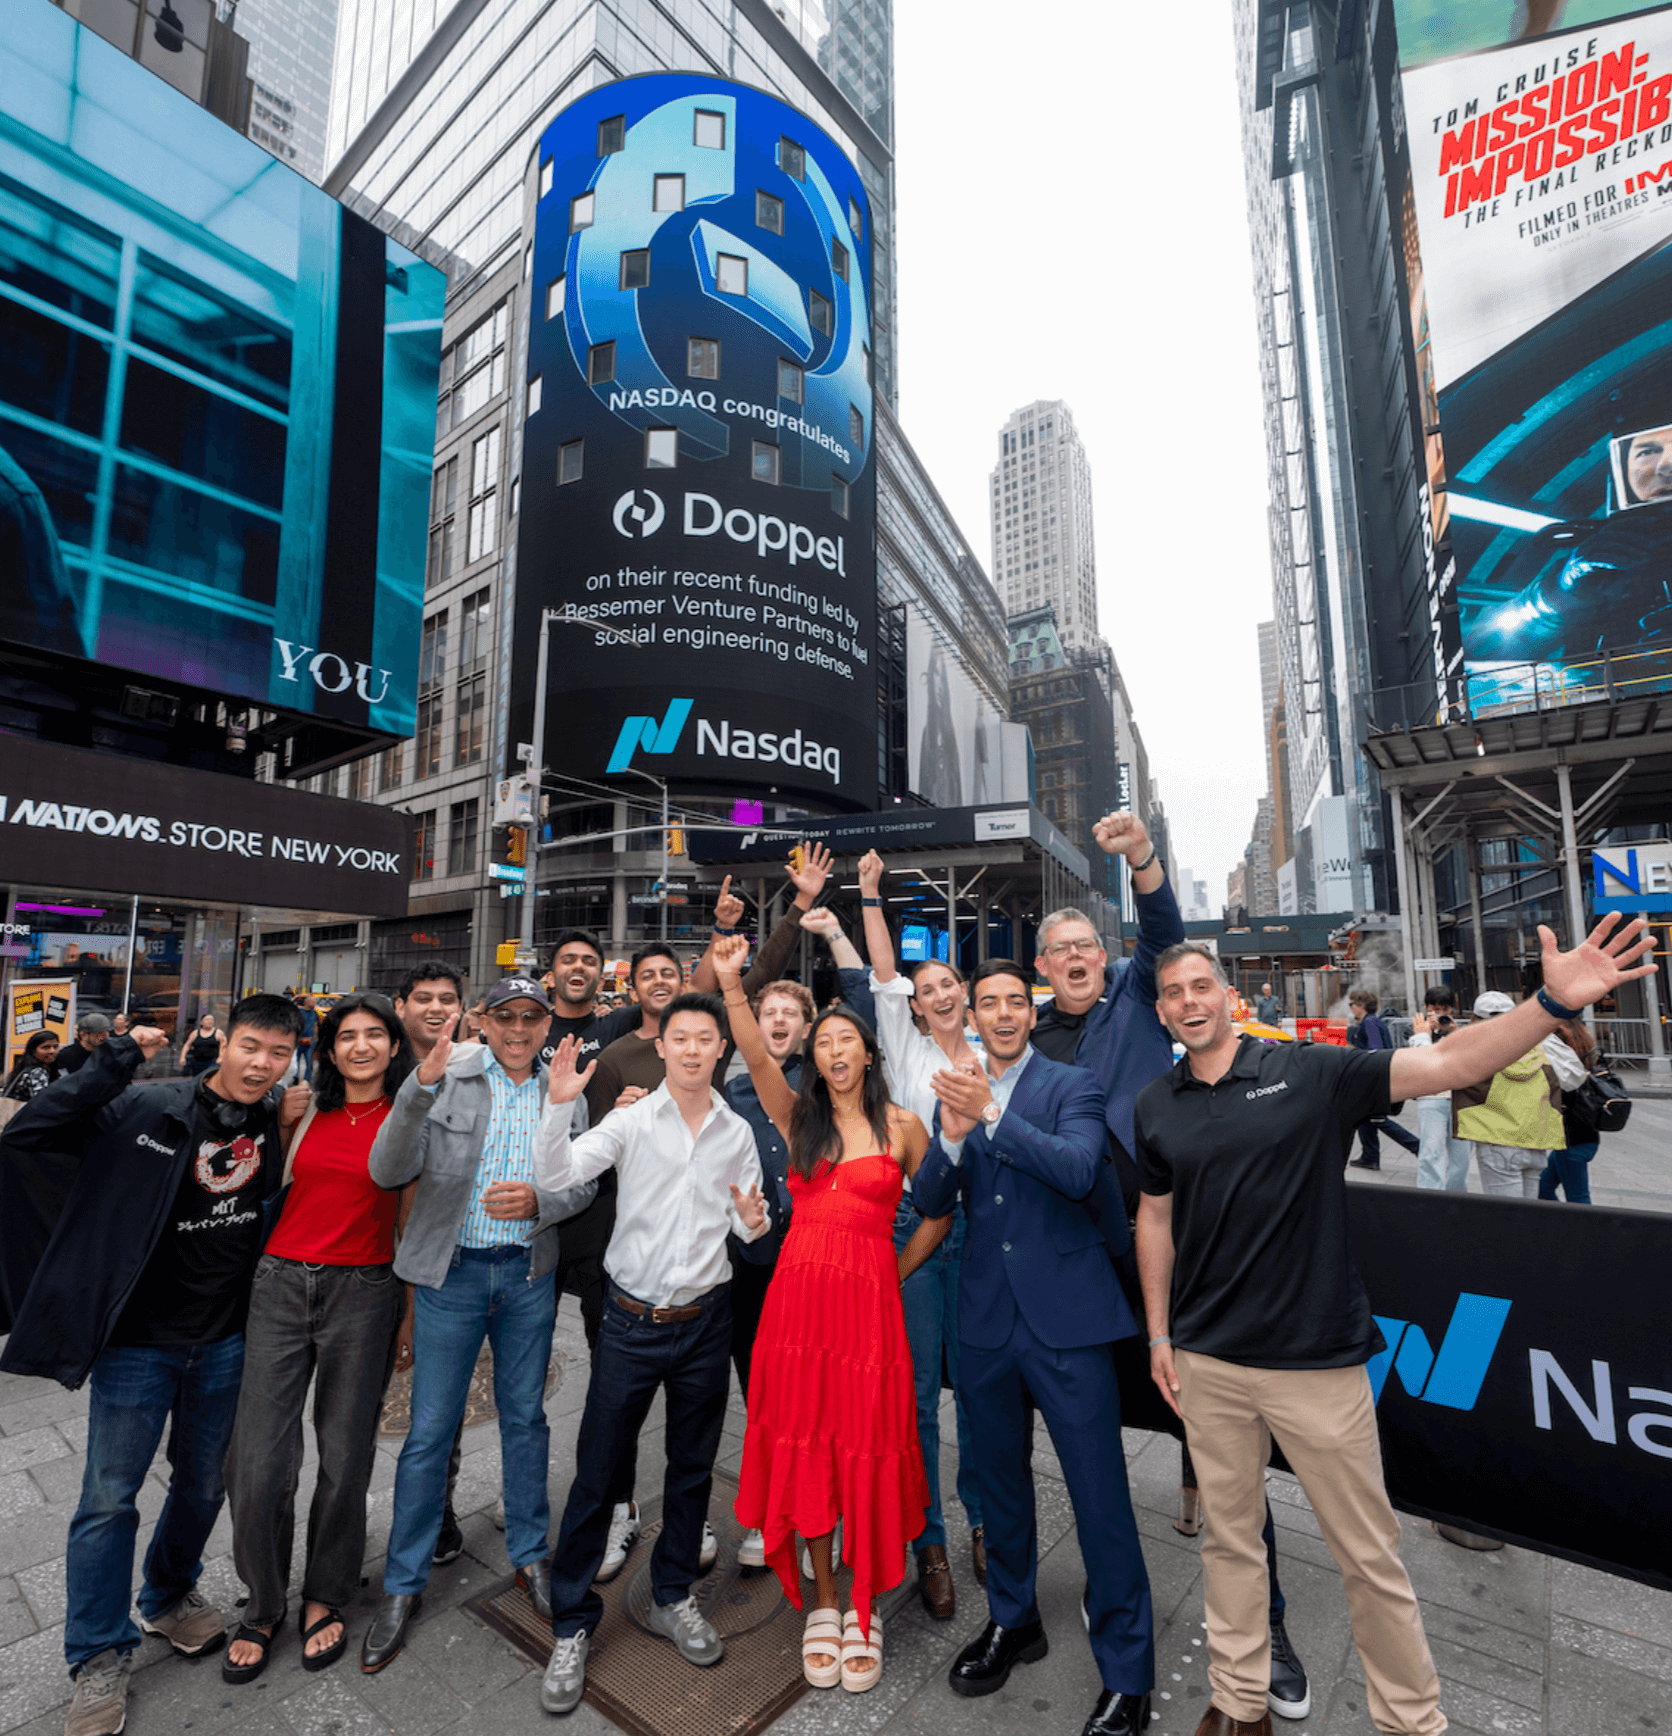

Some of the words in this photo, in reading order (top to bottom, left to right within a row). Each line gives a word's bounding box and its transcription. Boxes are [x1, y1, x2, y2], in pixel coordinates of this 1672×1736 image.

[1432, 98, 1479, 134] TOM
[1497, 38, 1598, 103] CRUISE
[1438, 41, 1650, 177] MISSION:
[1443, 73, 1672, 219] IMPOSSIB
[1464, 199, 1500, 229] THE
[1514, 166, 1578, 207] FINAL
[1518, 202, 1577, 239] FILMED
[1584, 185, 1618, 212] FOR
[1533, 228, 1562, 248] ONLY
[1567, 221, 1580, 234] IN
[1585, 190, 1649, 225] THEATRES
[609, 388, 717, 414] NASDAQ
[723, 398, 852, 465] congratulates
[683, 491, 847, 579] Doppel
[566, 597, 665, 622] Bessemer
[671, 595, 757, 622] Venture
[763, 605, 835, 646] Partners
[837, 633, 850, 653] to
[852, 639, 868, 666] fuel
[586, 574, 611, 592] on
[618, 566, 666, 588] their
[673, 568, 743, 592] recent
[748, 575, 818, 615] funding
[822, 595, 844, 620] led
[846, 611, 860, 637] by
[273, 637, 392, 704] YOU
[595, 624, 656, 647] social
[663, 625, 789, 661] engineering
[794, 642, 854, 680] defense.
[697, 719, 841, 785] Nasdaq
[169, 821, 263, 858] STORE
[272, 836, 331, 864] NEW
[333, 845, 400, 874] YORK
[804, 830, 830, 838] TODAY
[836, 826, 876, 836] REWRITE
[988, 823, 1016, 831] Turner
[1592, 849, 1672, 897] NE
[1256, 1080, 1288, 1098] Doppel
[147, 1139, 176, 1156] Doppel
[212, 1196, 238, 1215] MIT
